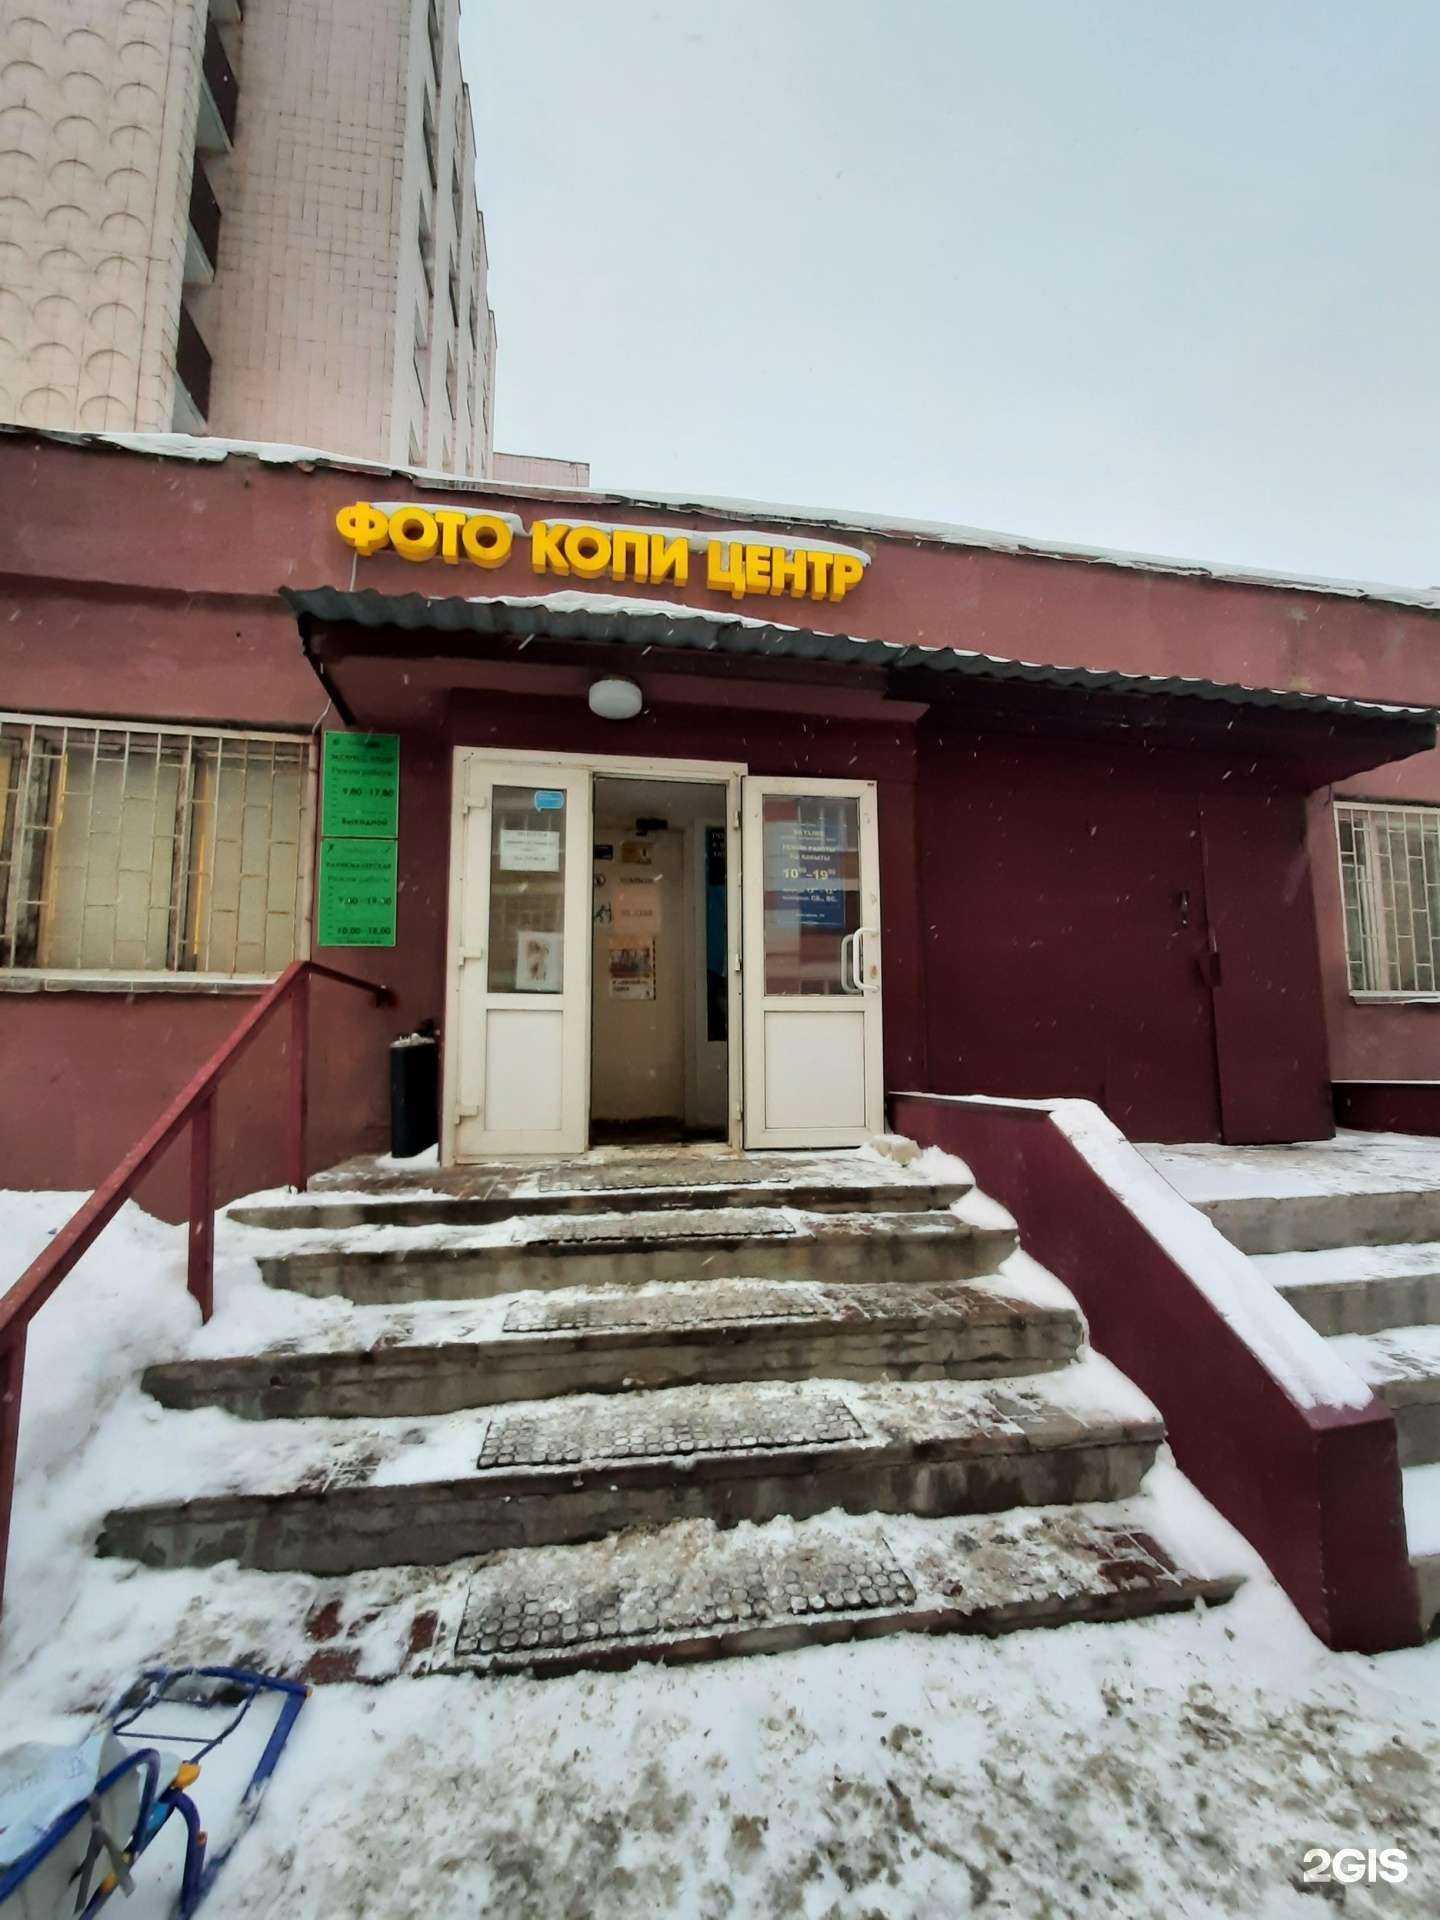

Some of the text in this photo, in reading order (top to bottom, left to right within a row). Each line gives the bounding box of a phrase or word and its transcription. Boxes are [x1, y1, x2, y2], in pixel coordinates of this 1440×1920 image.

[336, 501, 864, 603] ФОТО КОПИ ЦЕНТР
